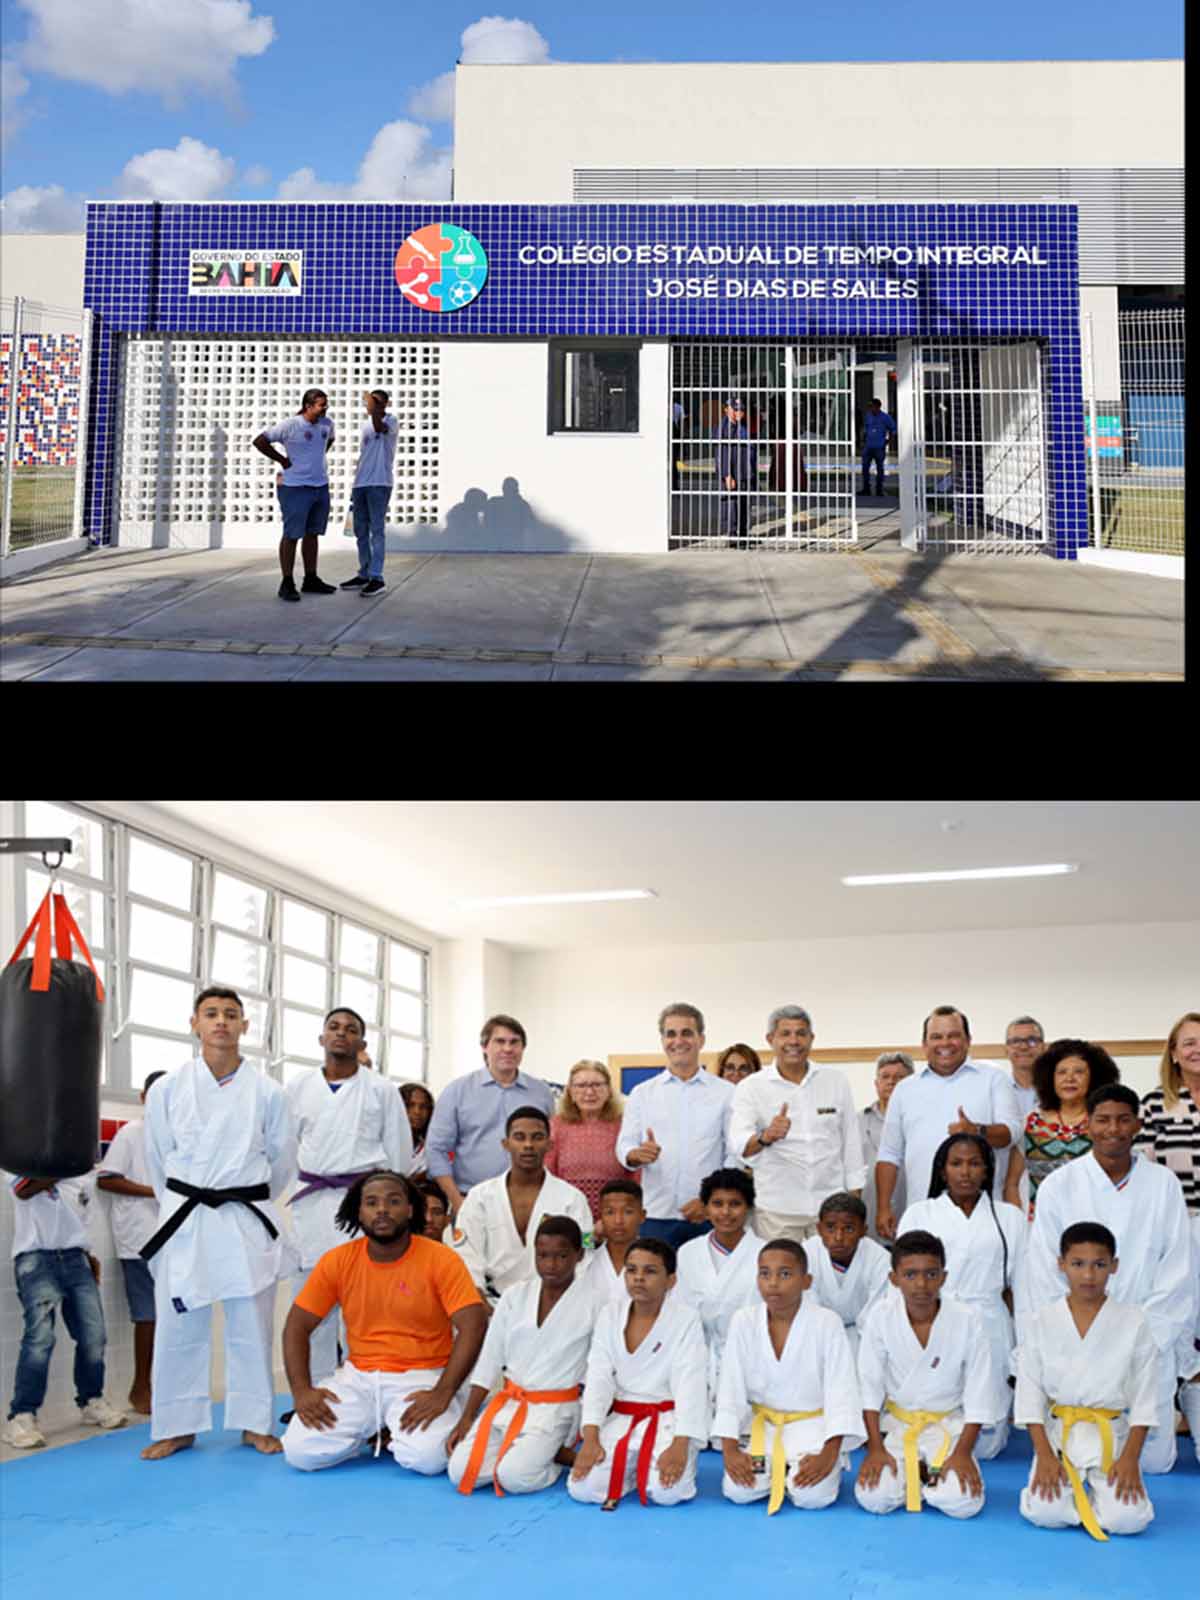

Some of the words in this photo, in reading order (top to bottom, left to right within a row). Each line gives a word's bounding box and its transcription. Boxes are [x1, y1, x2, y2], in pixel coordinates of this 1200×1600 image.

[244, 252, 260, 261] DO
[518, 240, 633, 265] COLÉGIO
[636, 244, 781, 265] ESTADUAL
[785, 246, 819, 265] DE
[823, 246, 913, 265] TEMPO
[917, 245, 1048, 265] INTEGRAL
[192, 262, 298, 287] BAHIA
[646, 275, 719, 298] JOSÉ
[726, 278, 787, 298] DIAS
[793, 280, 826, 298] DE
[831, 279, 919, 299] SALES
